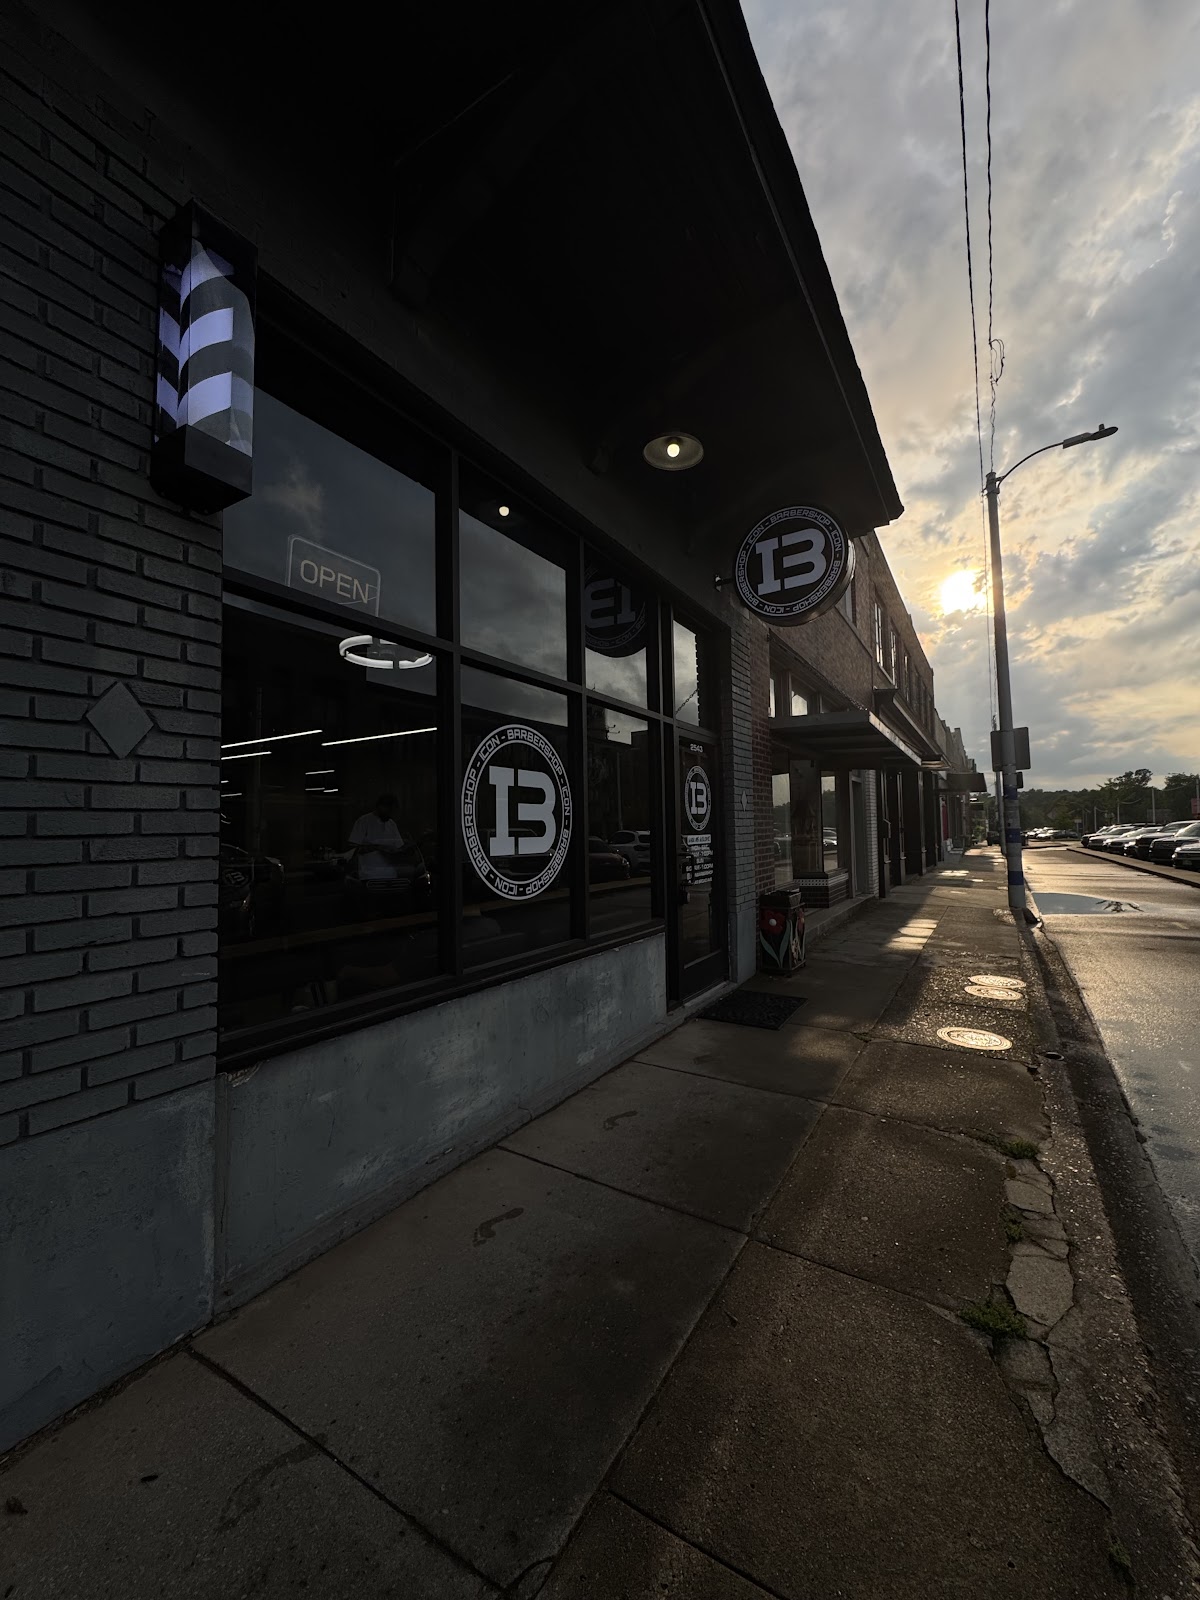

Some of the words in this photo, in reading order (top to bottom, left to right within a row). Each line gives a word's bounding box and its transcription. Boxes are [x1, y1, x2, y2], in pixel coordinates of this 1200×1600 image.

[770, 508, 831, 526] BARBERSHOP
[747, 524, 765, 545] ICON
[830, 529, 843, 552] ICON
[300, 559, 369, 604] OPEN
[737, 550, 759, 606] BARBERSHOP
[792, 560, 842, 612] BARBERSHOP
[763, 605, 785, 614] ICON
[478, 734, 502, 761] ICON
[506, 728, 563, 776] BARBERSHOP
[561, 785, 571, 817] ICON
[463, 768, 492, 877] BARBERSHOP
[525, 829, 570, 895] BARBERSHOP
[494, 879, 518, 896] ICON
